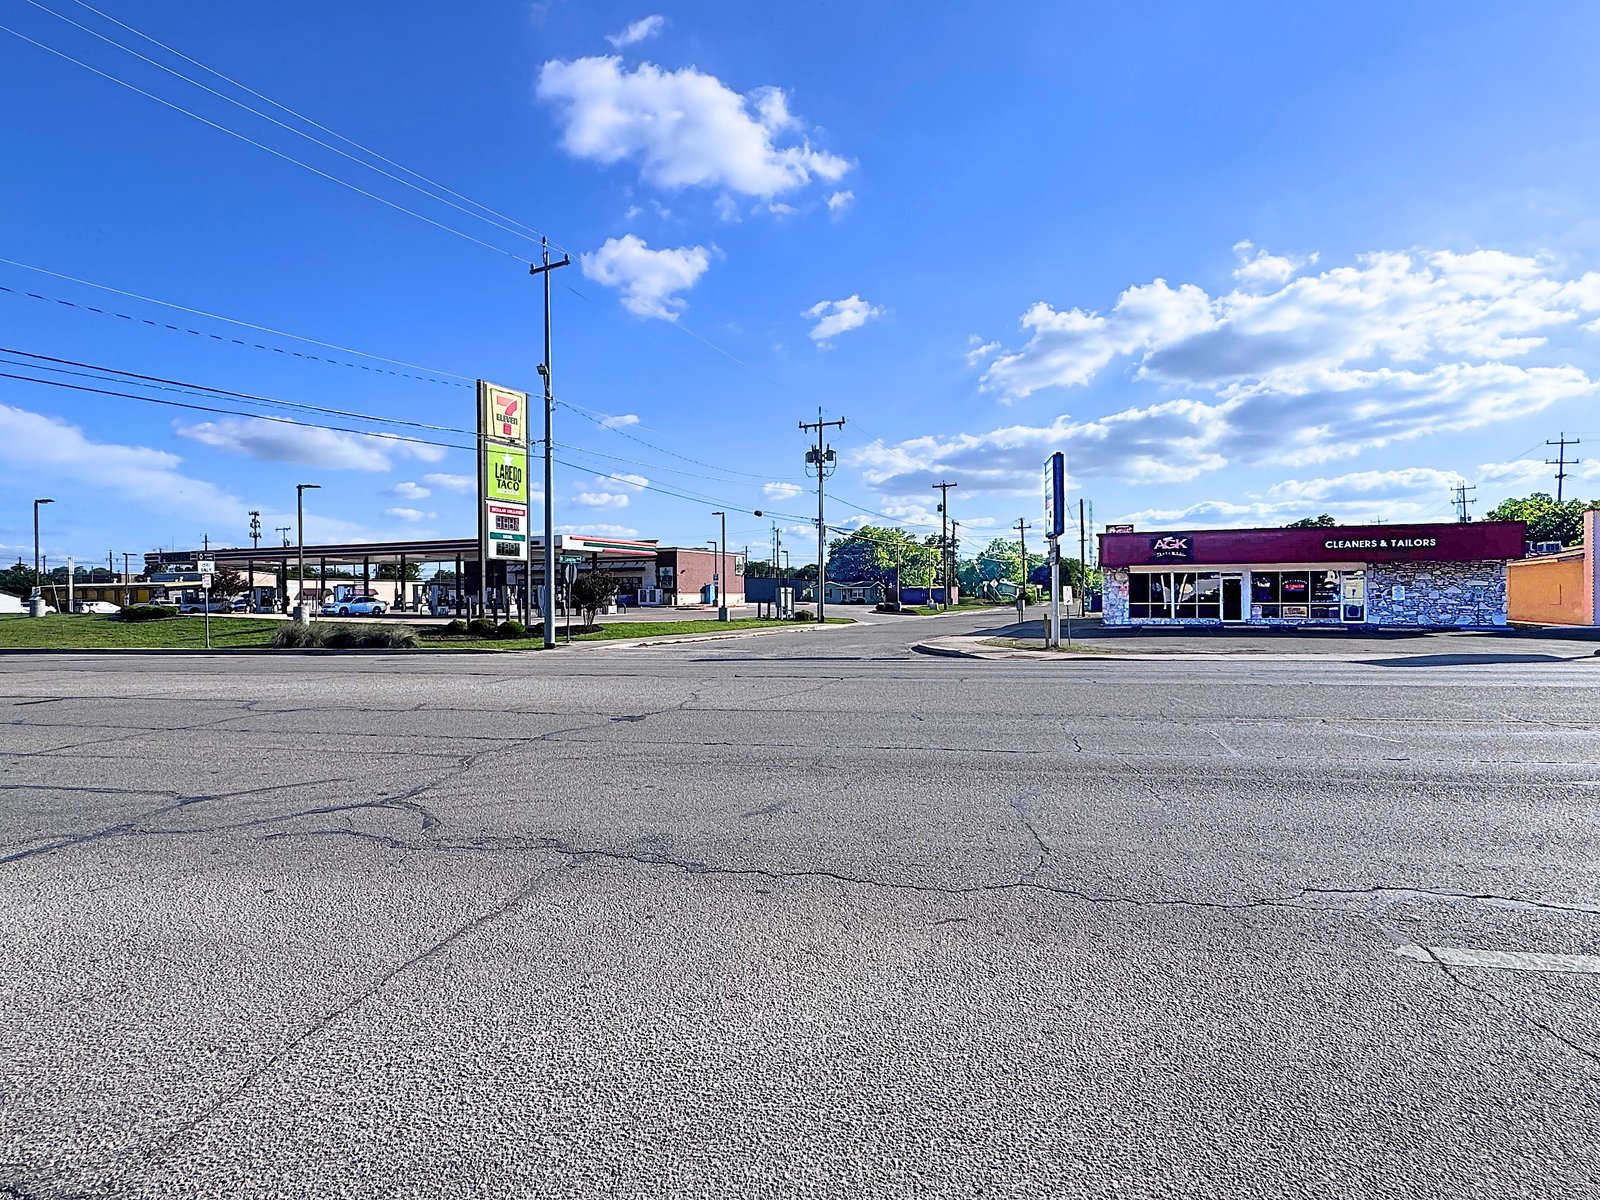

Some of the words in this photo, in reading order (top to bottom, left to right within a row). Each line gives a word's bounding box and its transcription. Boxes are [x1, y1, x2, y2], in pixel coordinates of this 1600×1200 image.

[496, 395, 518, 416] 7
[495, 462, 522, 484] LAREDO
[496, 478, 520, 491] TACO
[1154, 537, 1188, 549] AGK
[1324, 540, 1377, 549] CLEANERS
[1379, 539, 1388, 547] &
[1391, 538, 1436, 547] TAILORS
